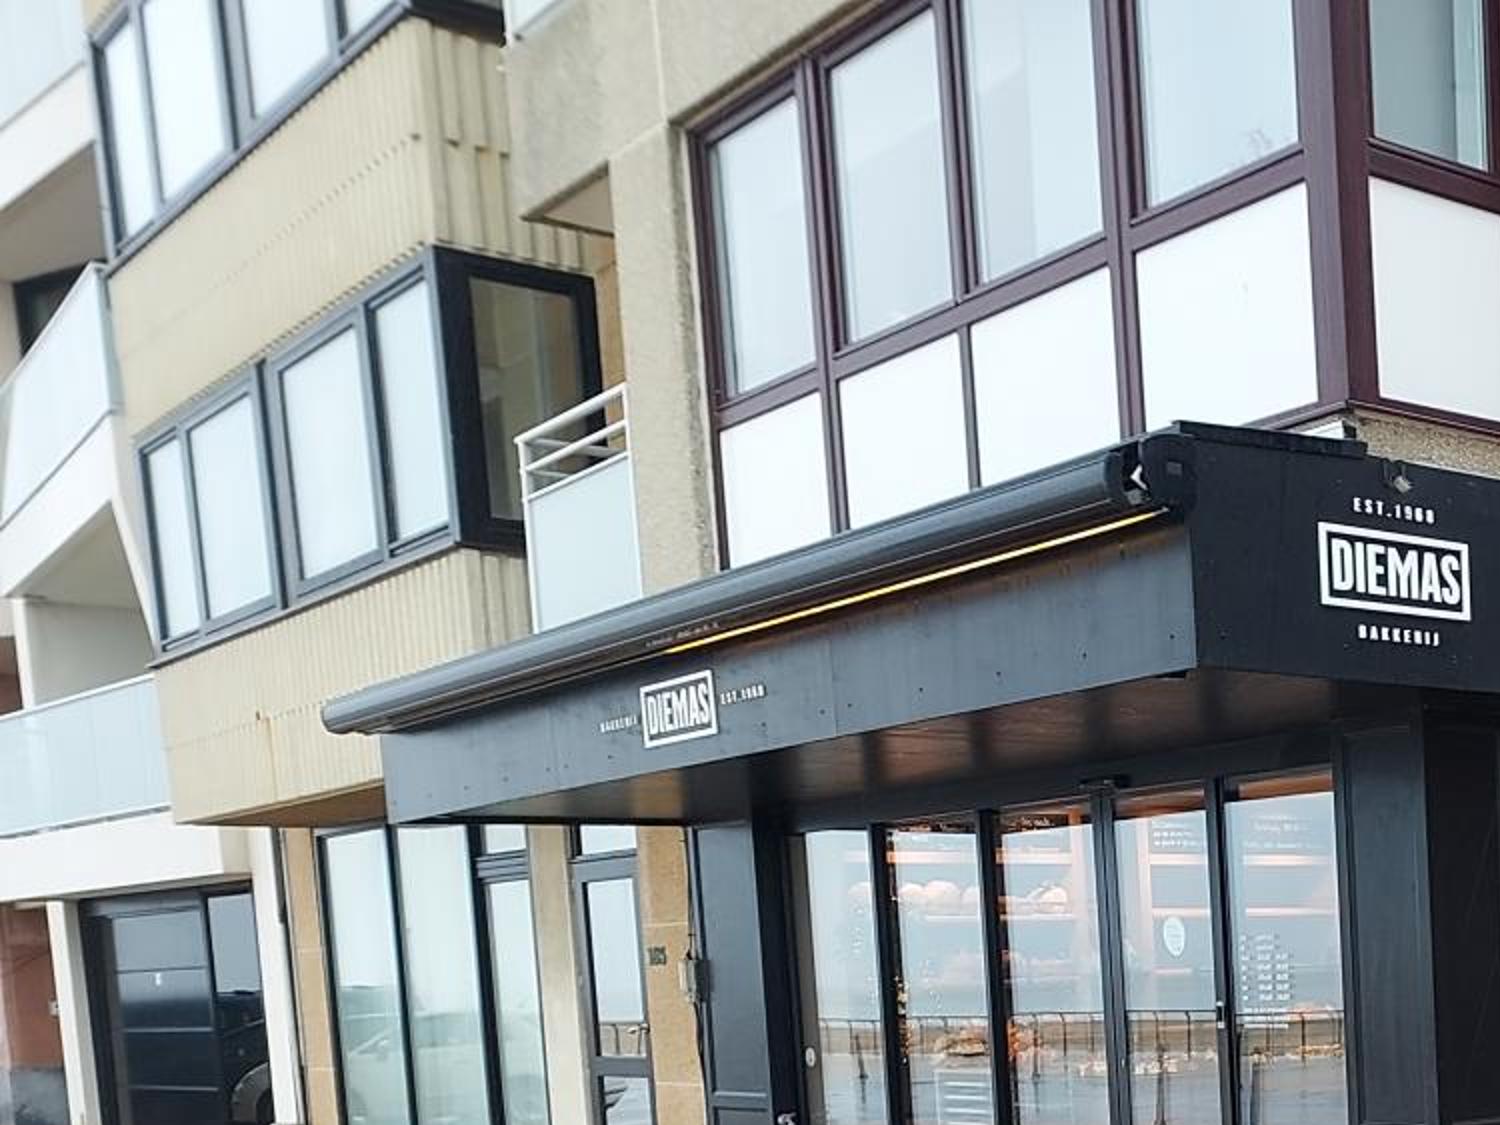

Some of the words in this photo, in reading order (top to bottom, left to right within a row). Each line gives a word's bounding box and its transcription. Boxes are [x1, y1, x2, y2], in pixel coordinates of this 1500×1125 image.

[1331, 537, 1462, 606] DIEMAS
[1357, 623, 1440, 647] BAKKERIJ
[646, 682, 711, 736] DIEMAS
